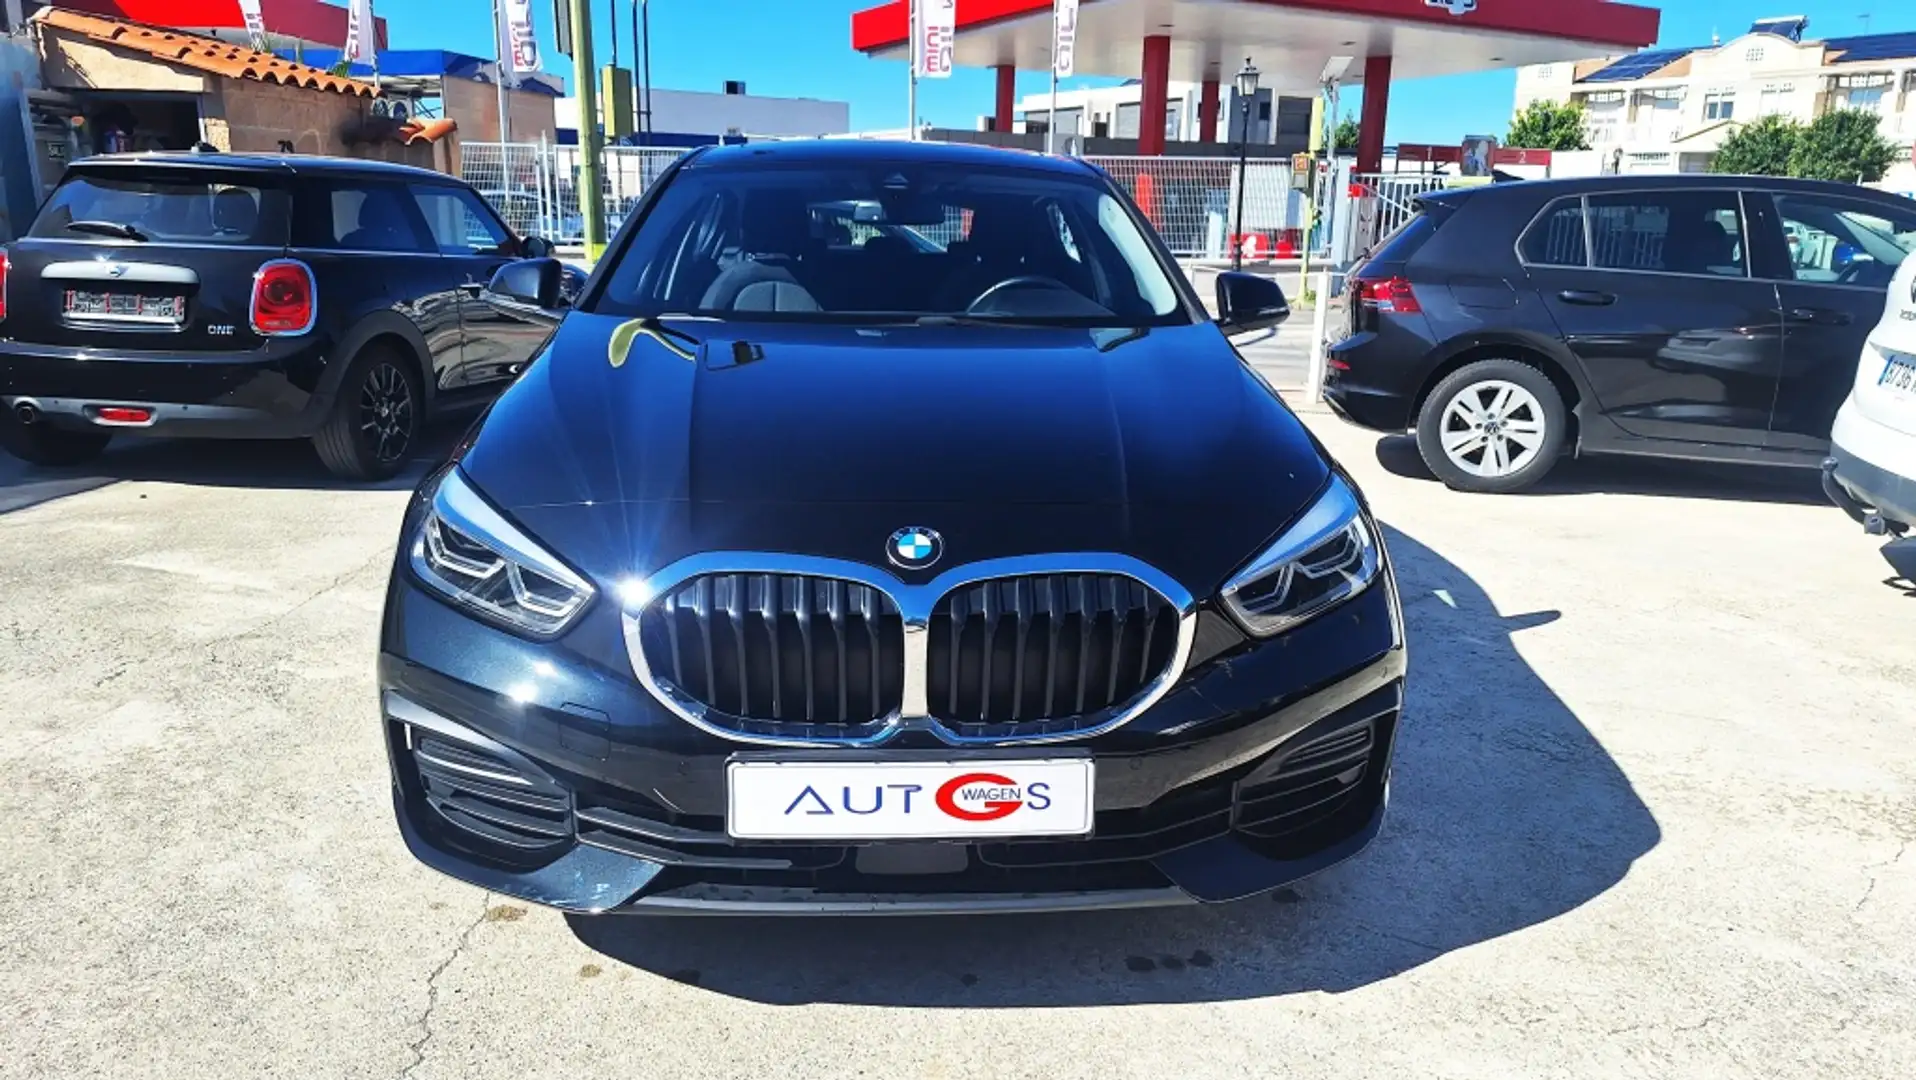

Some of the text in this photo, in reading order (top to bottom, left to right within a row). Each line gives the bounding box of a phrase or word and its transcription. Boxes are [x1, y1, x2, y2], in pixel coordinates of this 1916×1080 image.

[927, 26, 939, 72] mini
[1519, 151, 1526, 163] 2
[207, 325, 234, 335] ONE
[961, 787, 1021, 801] WAGEN
